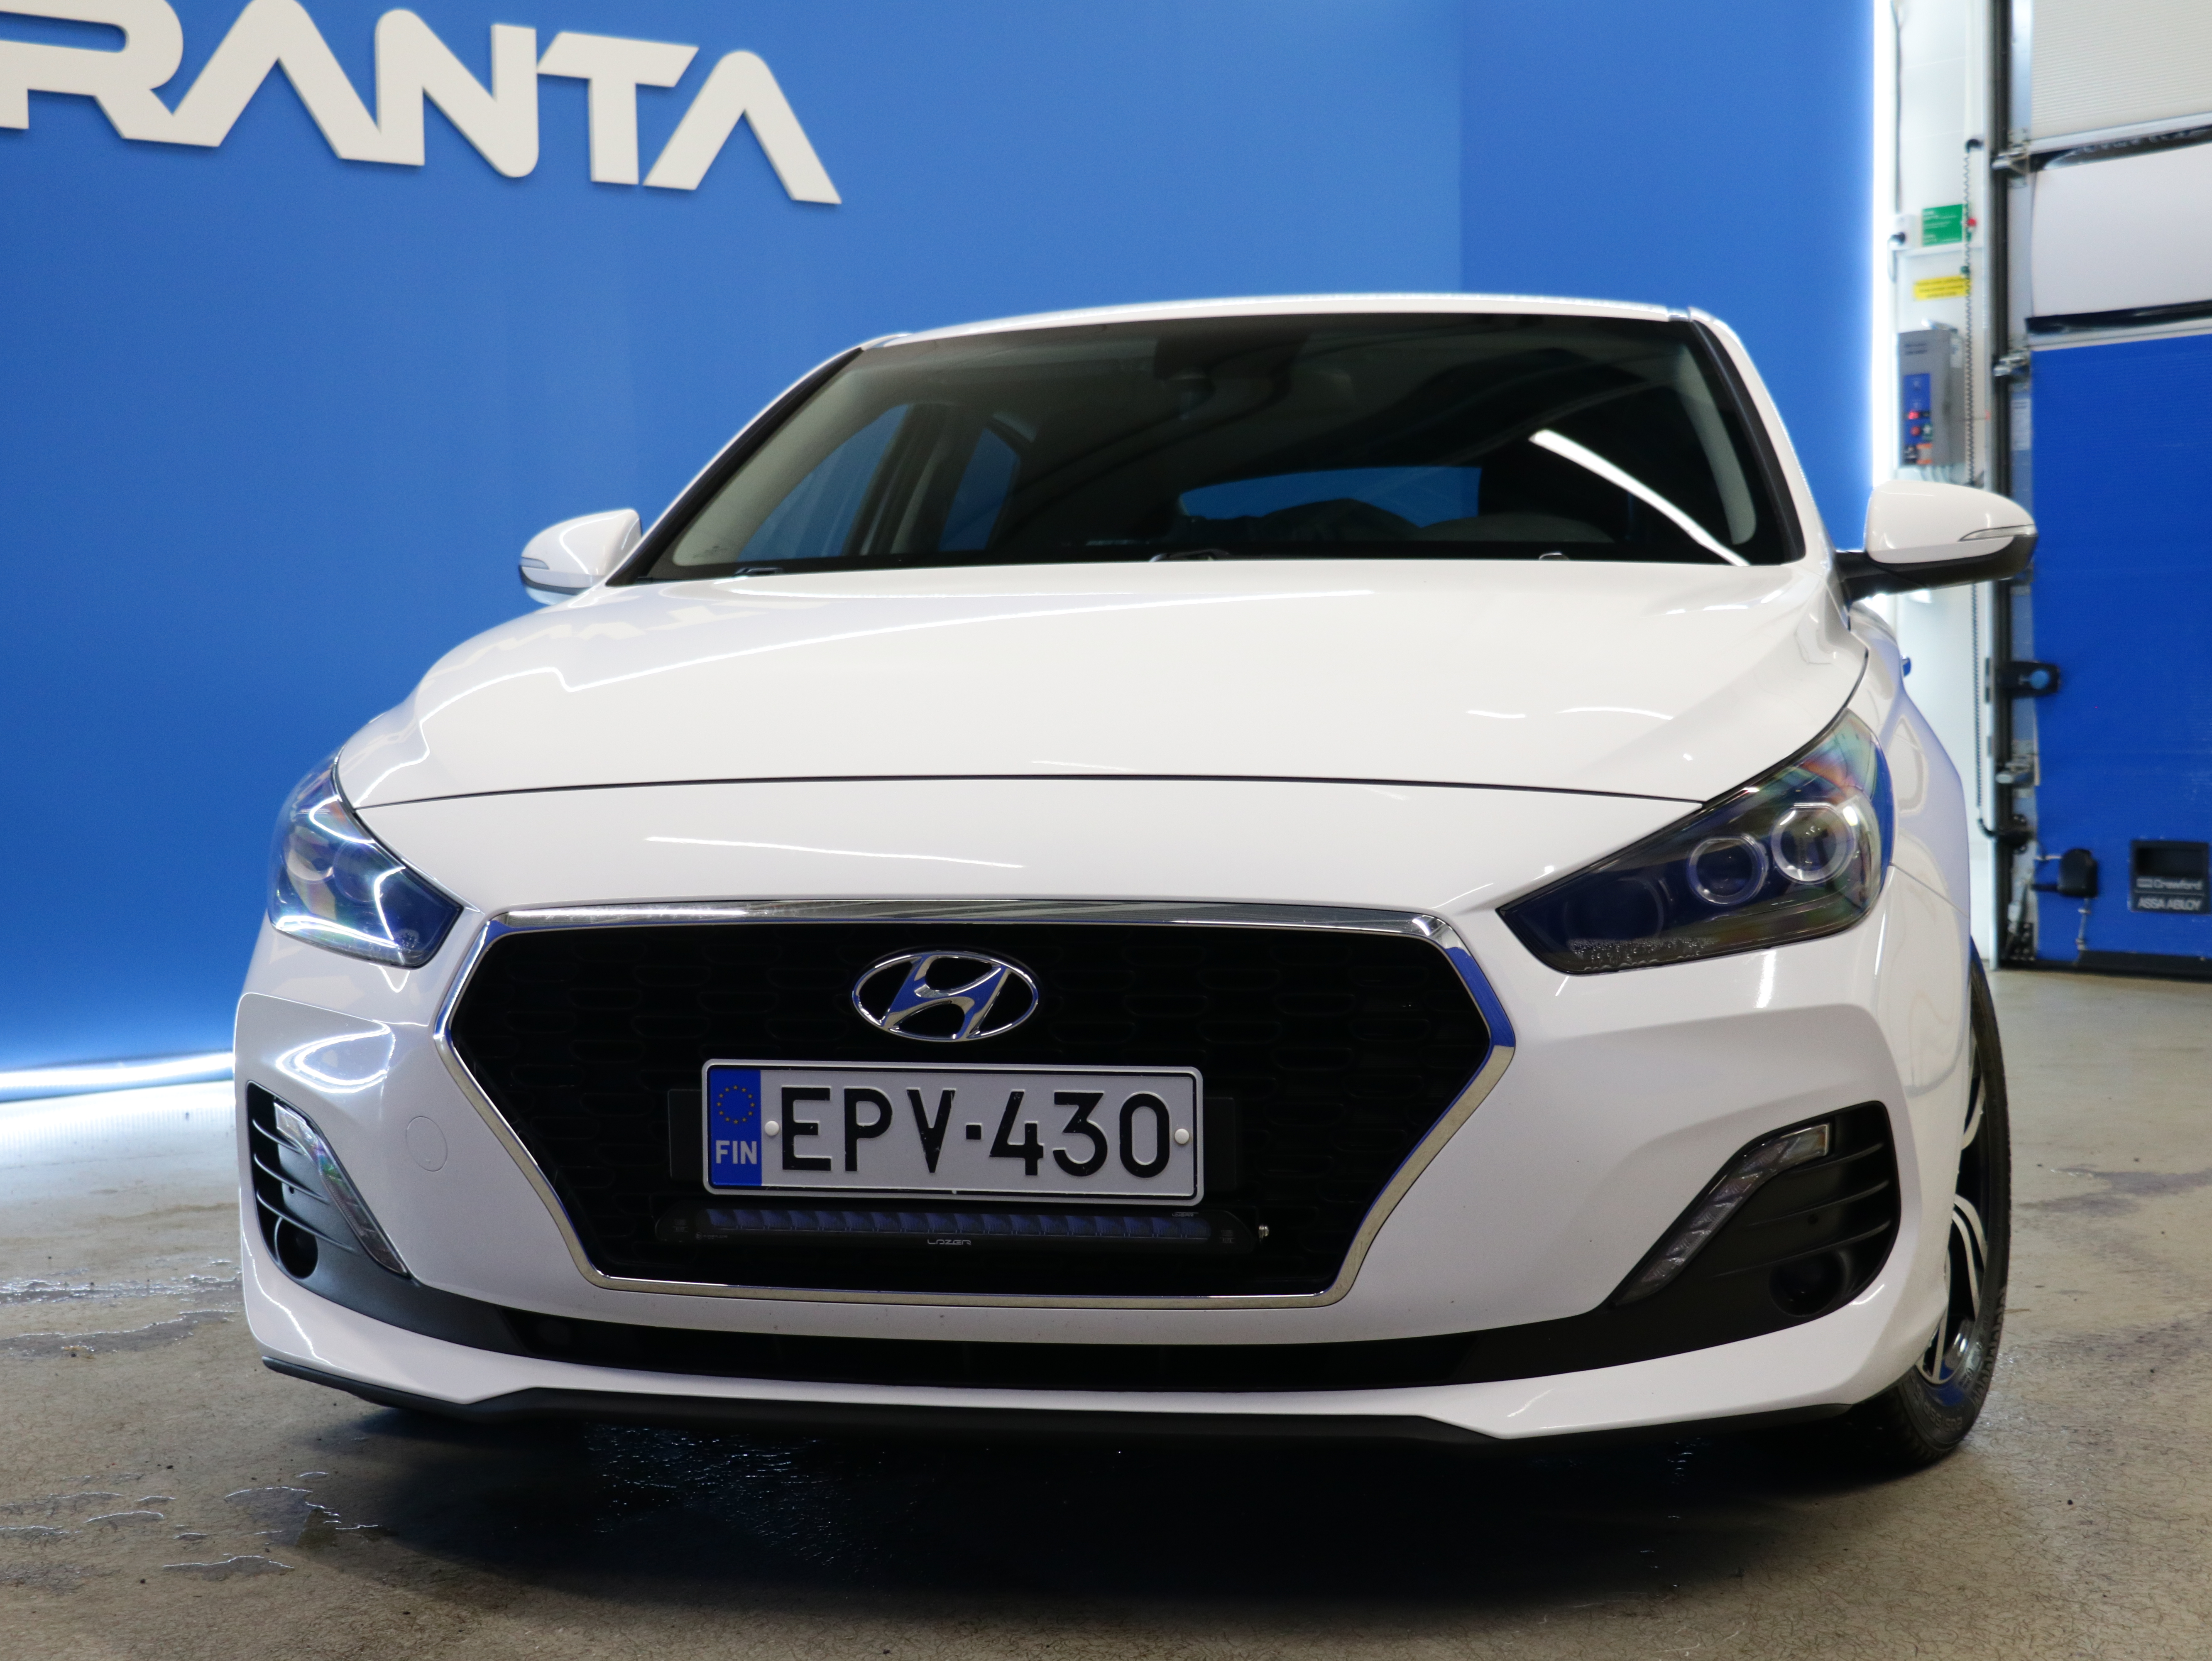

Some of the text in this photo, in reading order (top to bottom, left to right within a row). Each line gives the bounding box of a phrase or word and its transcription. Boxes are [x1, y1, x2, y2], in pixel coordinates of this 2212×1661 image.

[2138, 897, 2202, 911] ASSA ABLOY
[715, 1085, 1171, 1178] FIN EPV-430
